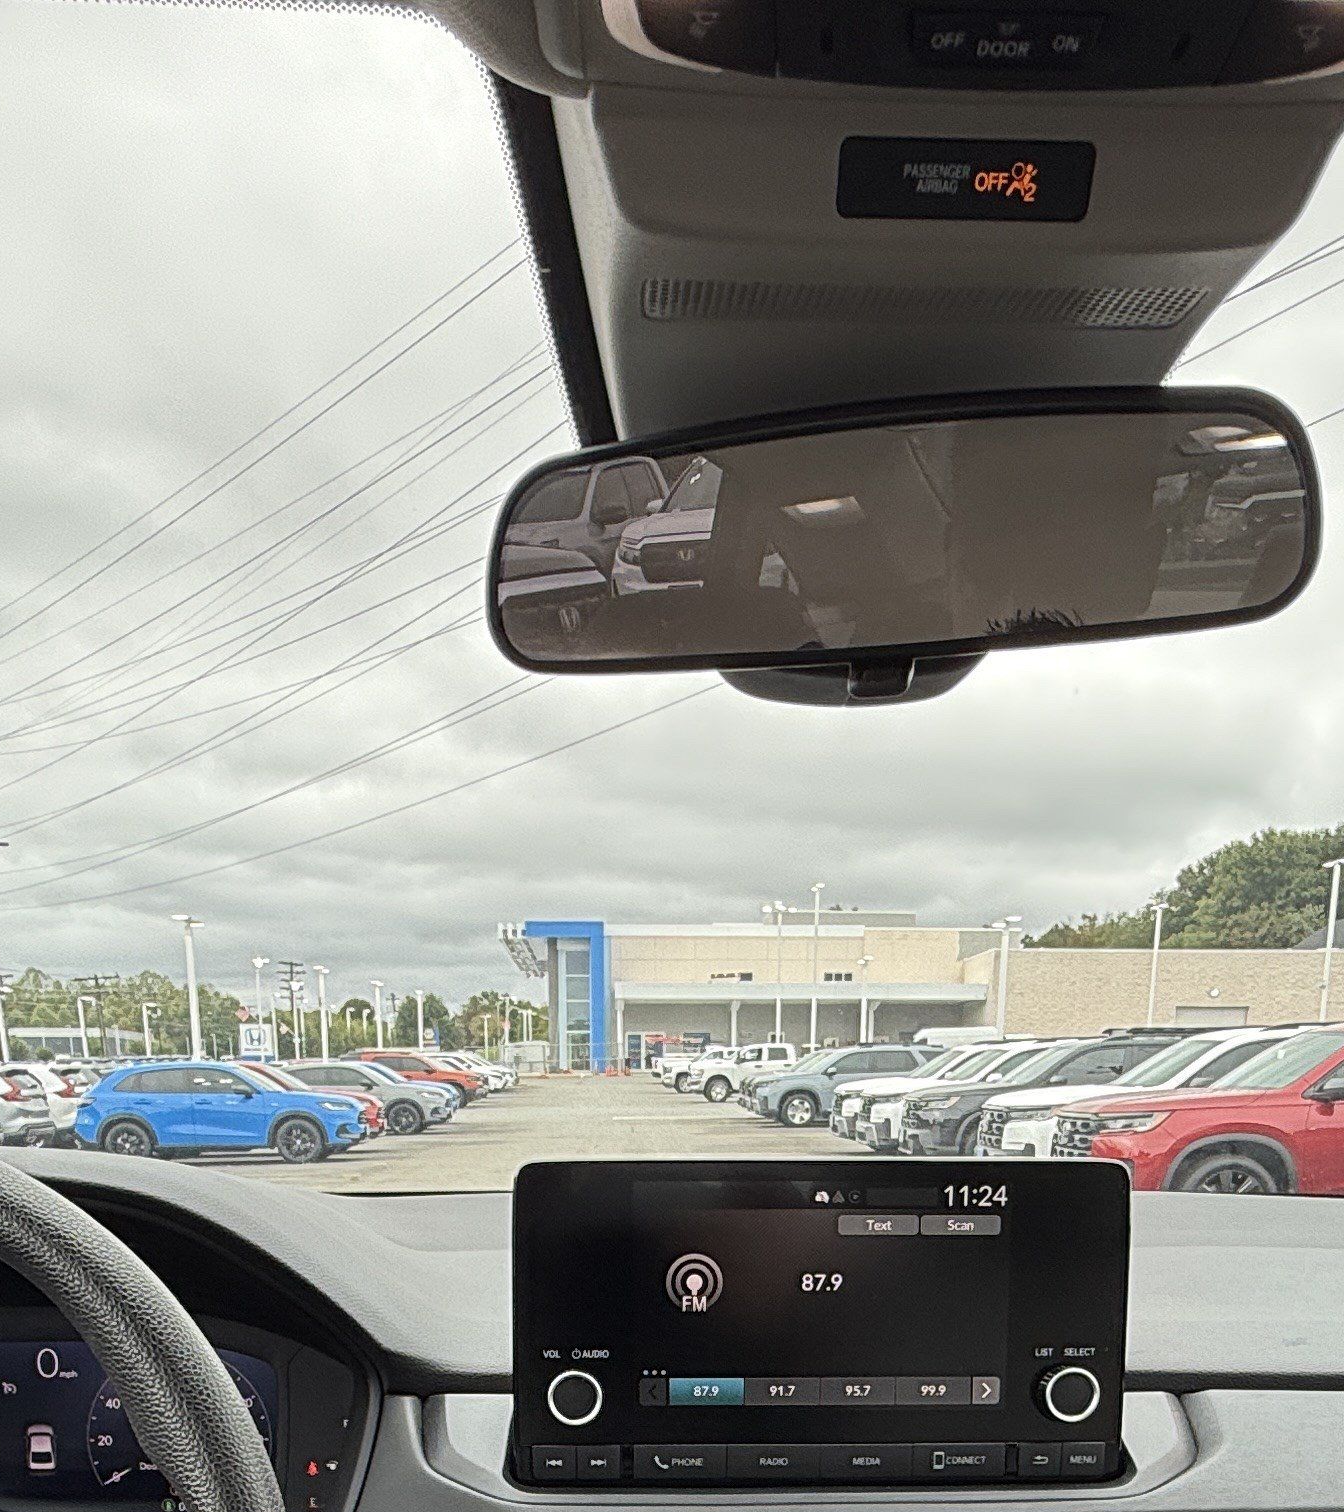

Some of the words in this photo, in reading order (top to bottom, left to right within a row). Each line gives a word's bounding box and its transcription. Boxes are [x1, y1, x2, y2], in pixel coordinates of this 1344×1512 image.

[931, 32, 966, 49] OFF
[977, 41, 1030, 57] DOOR
[1054, 34, 1079, 51] ON
[903, 163, 970, 179] PASSENGER
[916, 179, 959, 193] AIRBAG
[975, 172, 1009, 191] OFF
[944, 1185, 1008, 1207] 11:24
[865, 1219, 893, 1232] Text
[947, 1219, 975, 1232] Scan
[801, 1273, 844, 1292] 87.9
[682, 1295, 708, 1313] FM
[542, 1349, 561, 1359] VOL
[581, 1349, 610, 1359] AUDIO
[1035, 1347, 1054, 1357] LIST
[1064, 1347, 1096, 1357] SELECT
[36, 1348, 58, 1378] 0
[693, 1385, 720, 1396] 87.9
[769, 1385, 796, 1396] 91.7
[844, 1385, 871, 1396] 95.7
[920, 1385, 947, 1396] 99.9
[106, 1398, 121, 1409] 40
[97, 1435, 113, 1447] 20
[671, 1457, 704, 1467] PHONE
[759, 1456, 789, 1467] RADIO
[852, 1456, 881, 1466] MEDIA
[945, 1455, 987, 1465] CONNECT
[1069, 1454, 1098, 1464] MENU
